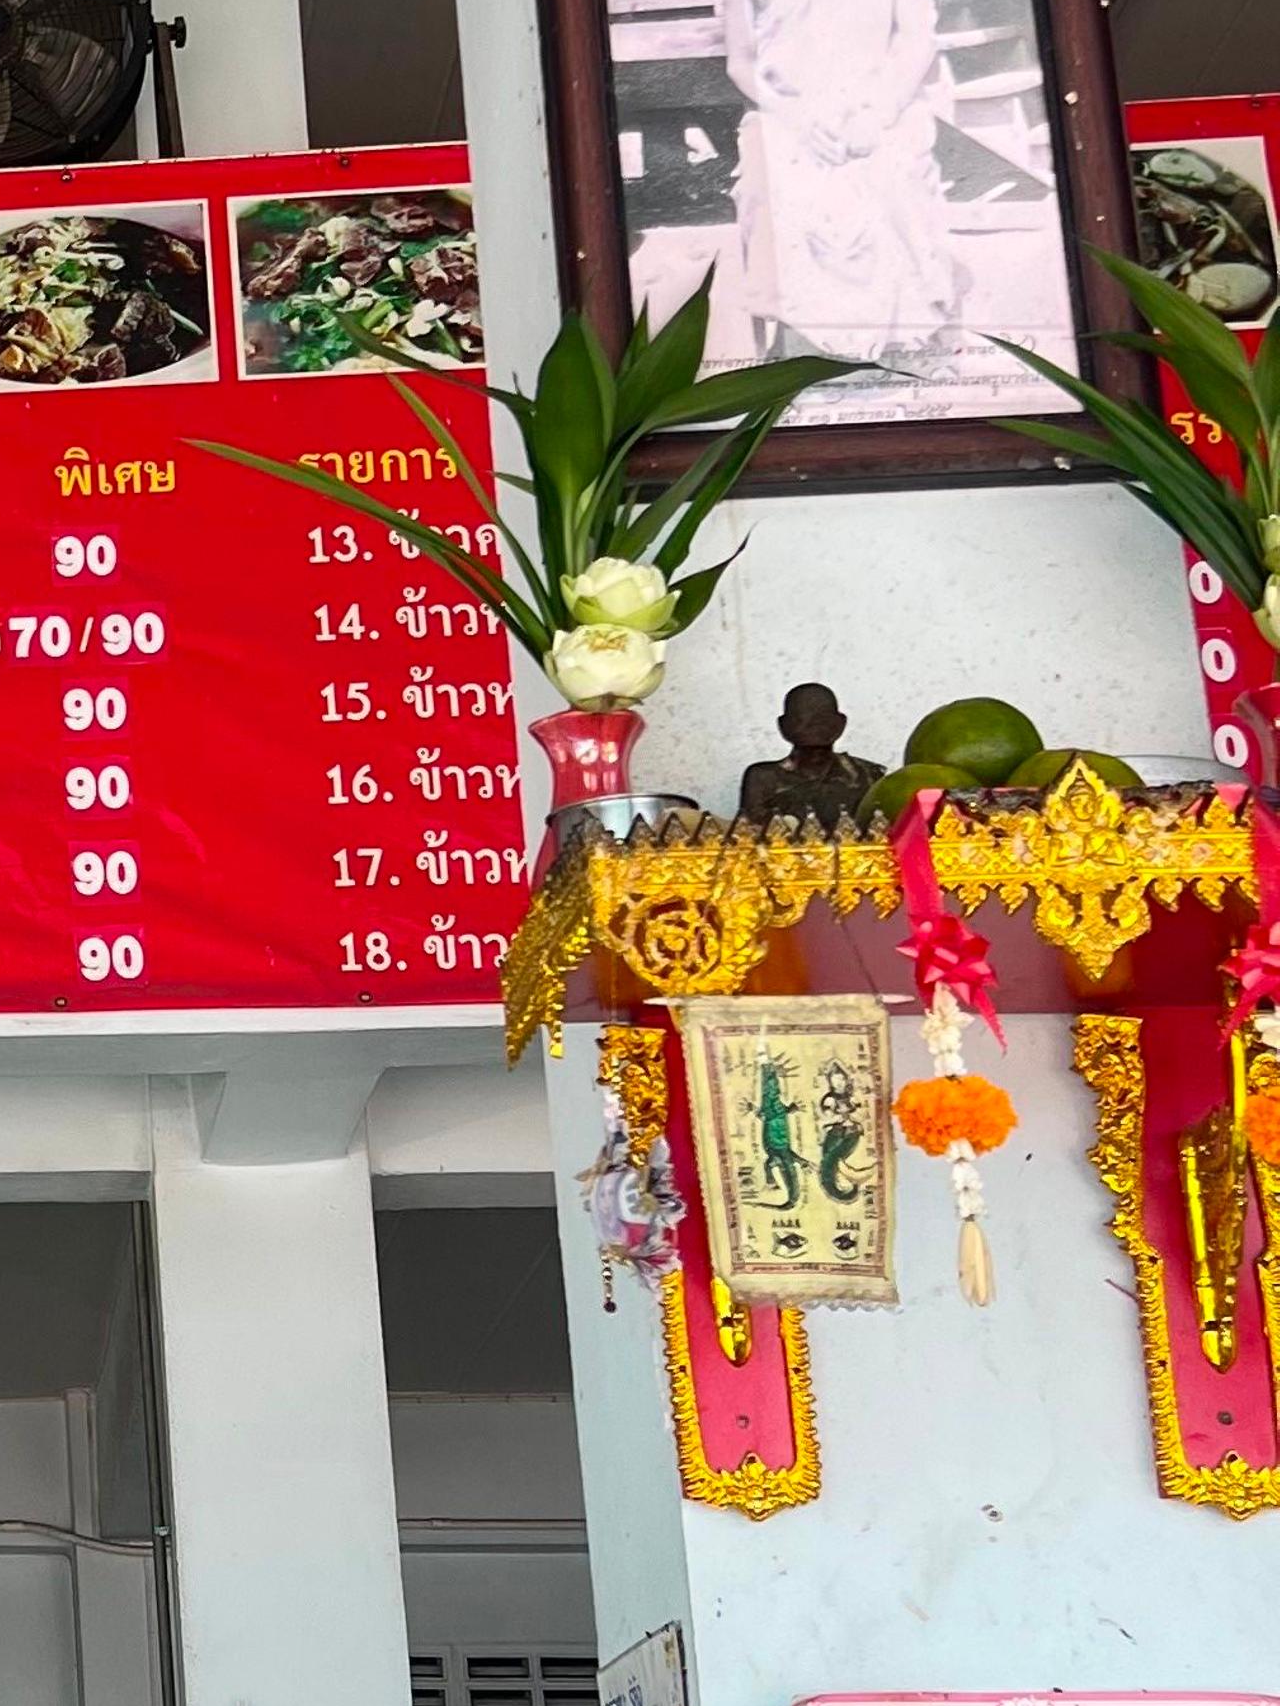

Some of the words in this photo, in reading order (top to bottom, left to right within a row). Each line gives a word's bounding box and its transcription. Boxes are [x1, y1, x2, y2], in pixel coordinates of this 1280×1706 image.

[54, 446, 175, 497] พิเศษ
[54, 534, 117, 577] 90
[308, 525, 373, 564] 13.
[314, 603, 380, 641] 14.
[62, 687, 127, 731] 90
[320, 682, 387, 722] 15.
[65, 765, 130, 810] 90
[326, 764, 394, 805] 16.
[72, 850, 138, 896] 90
[333, 848, 400, 887] 17.
[78, 934, 144, 982] 90
[339, 931, 408, 972] 18.
